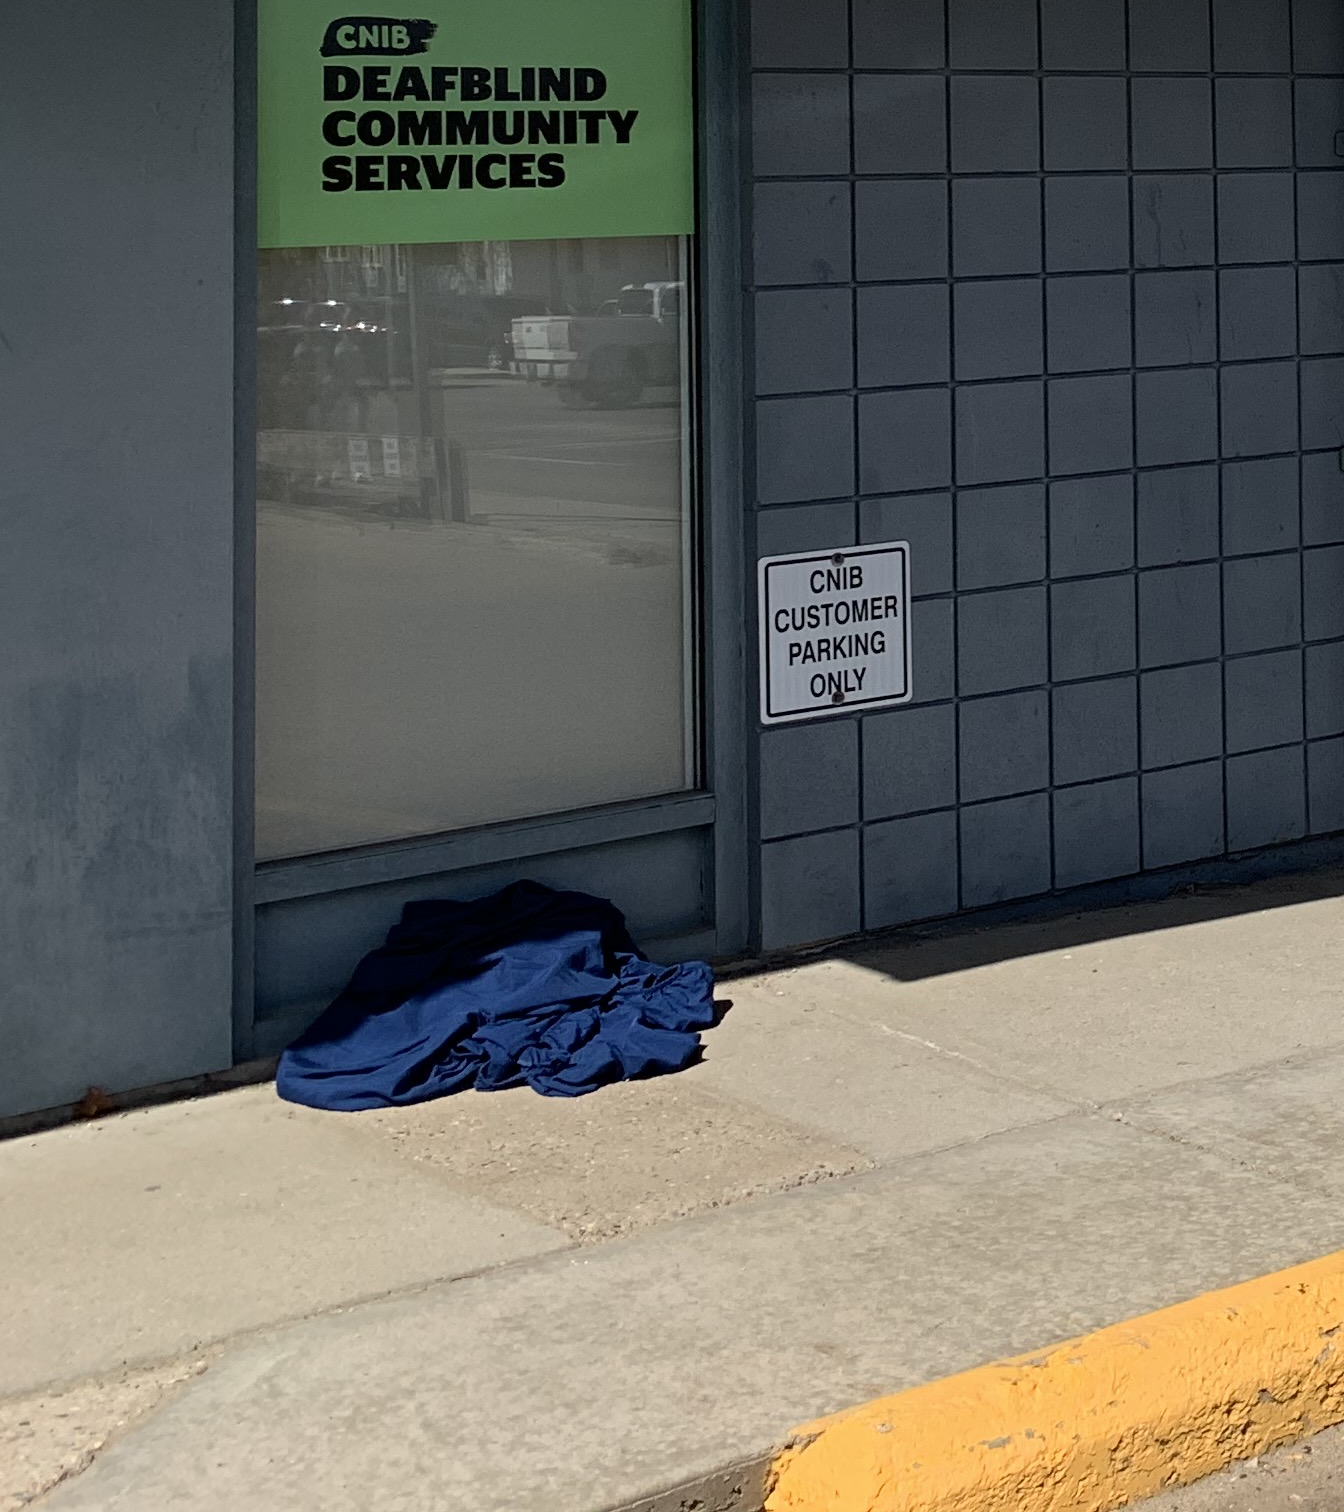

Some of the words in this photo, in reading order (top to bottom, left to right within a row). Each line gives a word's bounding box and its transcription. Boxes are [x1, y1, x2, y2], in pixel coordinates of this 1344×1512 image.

[336, 25, 411, 49] CNIB
[322, 65, 608, 102] DEAFBLIND
[322, 109, 639, 147] COMMUNITY
[322, 152, 566, 192] SERVICES
[810, 565, 863, 594] CNIB
[774, 595, 898, 633] CUSTOMER
[789, 630, 886, 666] PARKING
[810, 667, 866, 698] ONLY
